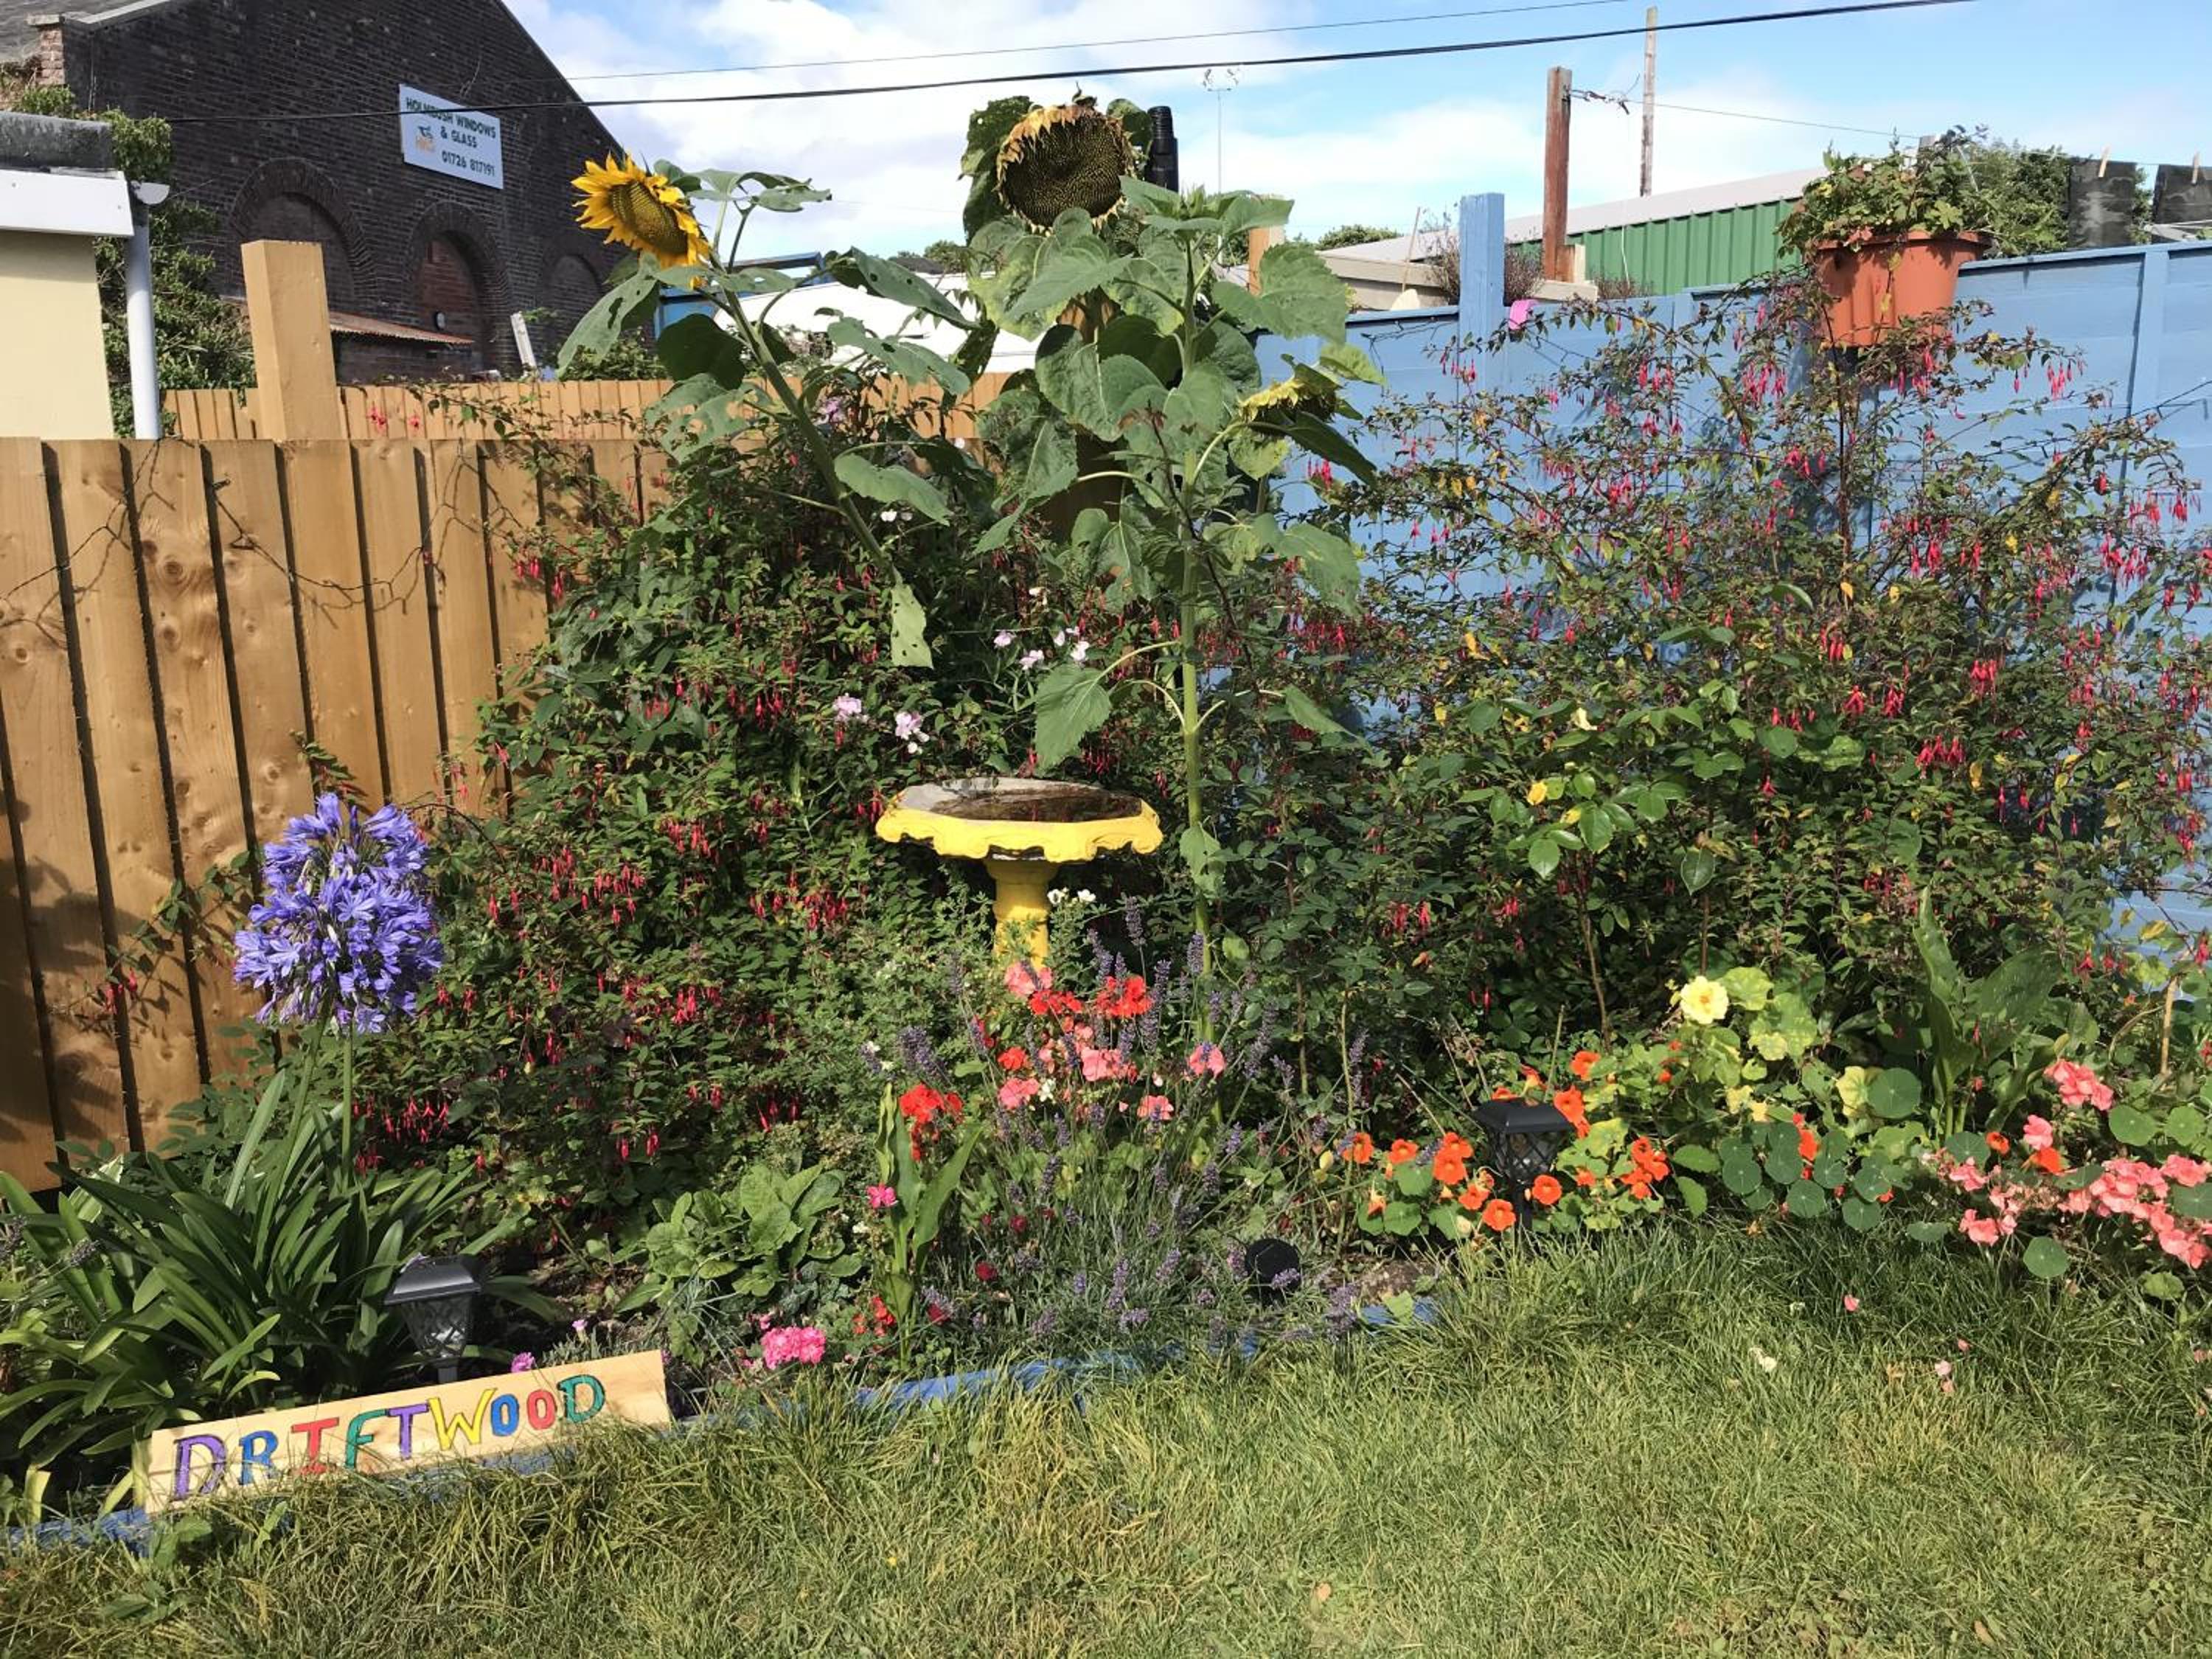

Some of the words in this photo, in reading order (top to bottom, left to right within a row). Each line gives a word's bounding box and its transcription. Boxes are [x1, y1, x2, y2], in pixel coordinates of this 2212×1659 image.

[440, 126, 448, 139] &
[451, 129, 478, 148] GLASS
[456, 114, 496, 139] WINDOWS
[442, 150, 467, 168] 01726
[170, 1374, 606, 1501] DRIFTWOOD
